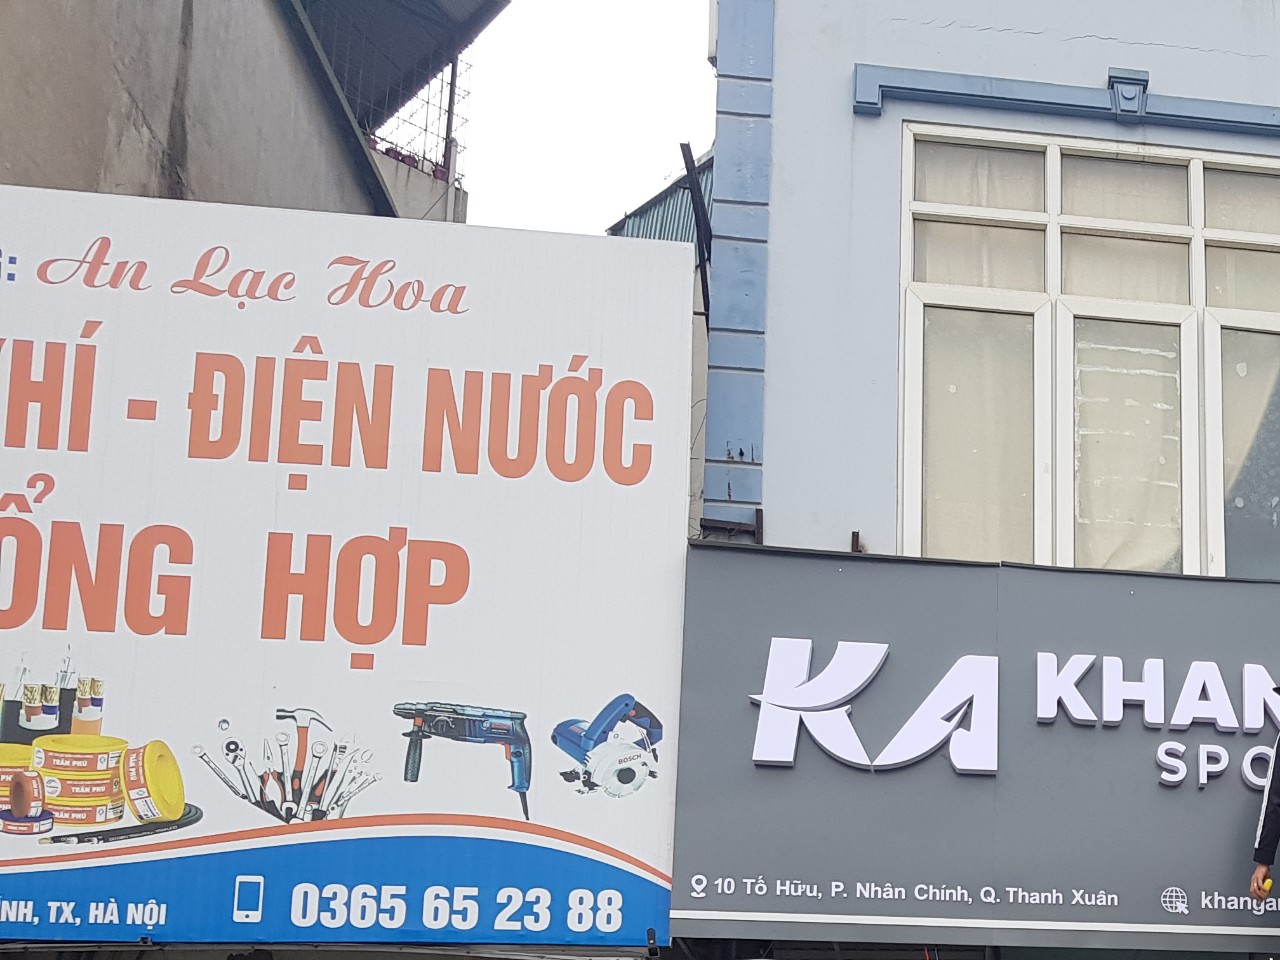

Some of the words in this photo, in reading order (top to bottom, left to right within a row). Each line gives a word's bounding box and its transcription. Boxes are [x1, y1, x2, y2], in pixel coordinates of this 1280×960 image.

[36, 236, 152, 291] An
[170, 245, 296, 310] Lạc
[327, 255, 470, 315] Hoa
[0, 320, 103, 452] HÍ
[187, 336, 394, 490] ĐIỆN
[422, 355, 654, 485] NƯỚC
[0, 473, 194, 635] ỔNG
[261, 526, 470, 669] HỢP
[748, 637, 999, 776] KA
[618, 753, 642, 765] BOSCH
[48, 901, 81, 926] TX,
[89, 898, 119, 924] HÀ
[126, 899, 167, 930] NỘI
[291, 883, 406, 930] 0365
[423, 886, 478, 931] 65
[494, 888, 551, 932] 23
[567, 890, 623, 933] 88
[714, 878, 735, 895] 10
[743, 875, 767, 897] Tố
[776, 879, 823, 899] Hữu,
[831, 881, 848, 898] P.
[856, 882, 906, 900] Nhân
[914, 883, 973, 904] Chính,
[980, 887, 1001, 903] Q.
[1005, 888, 1063, 905] Thanh
[1071, 889, 1118, 906] Xuân
